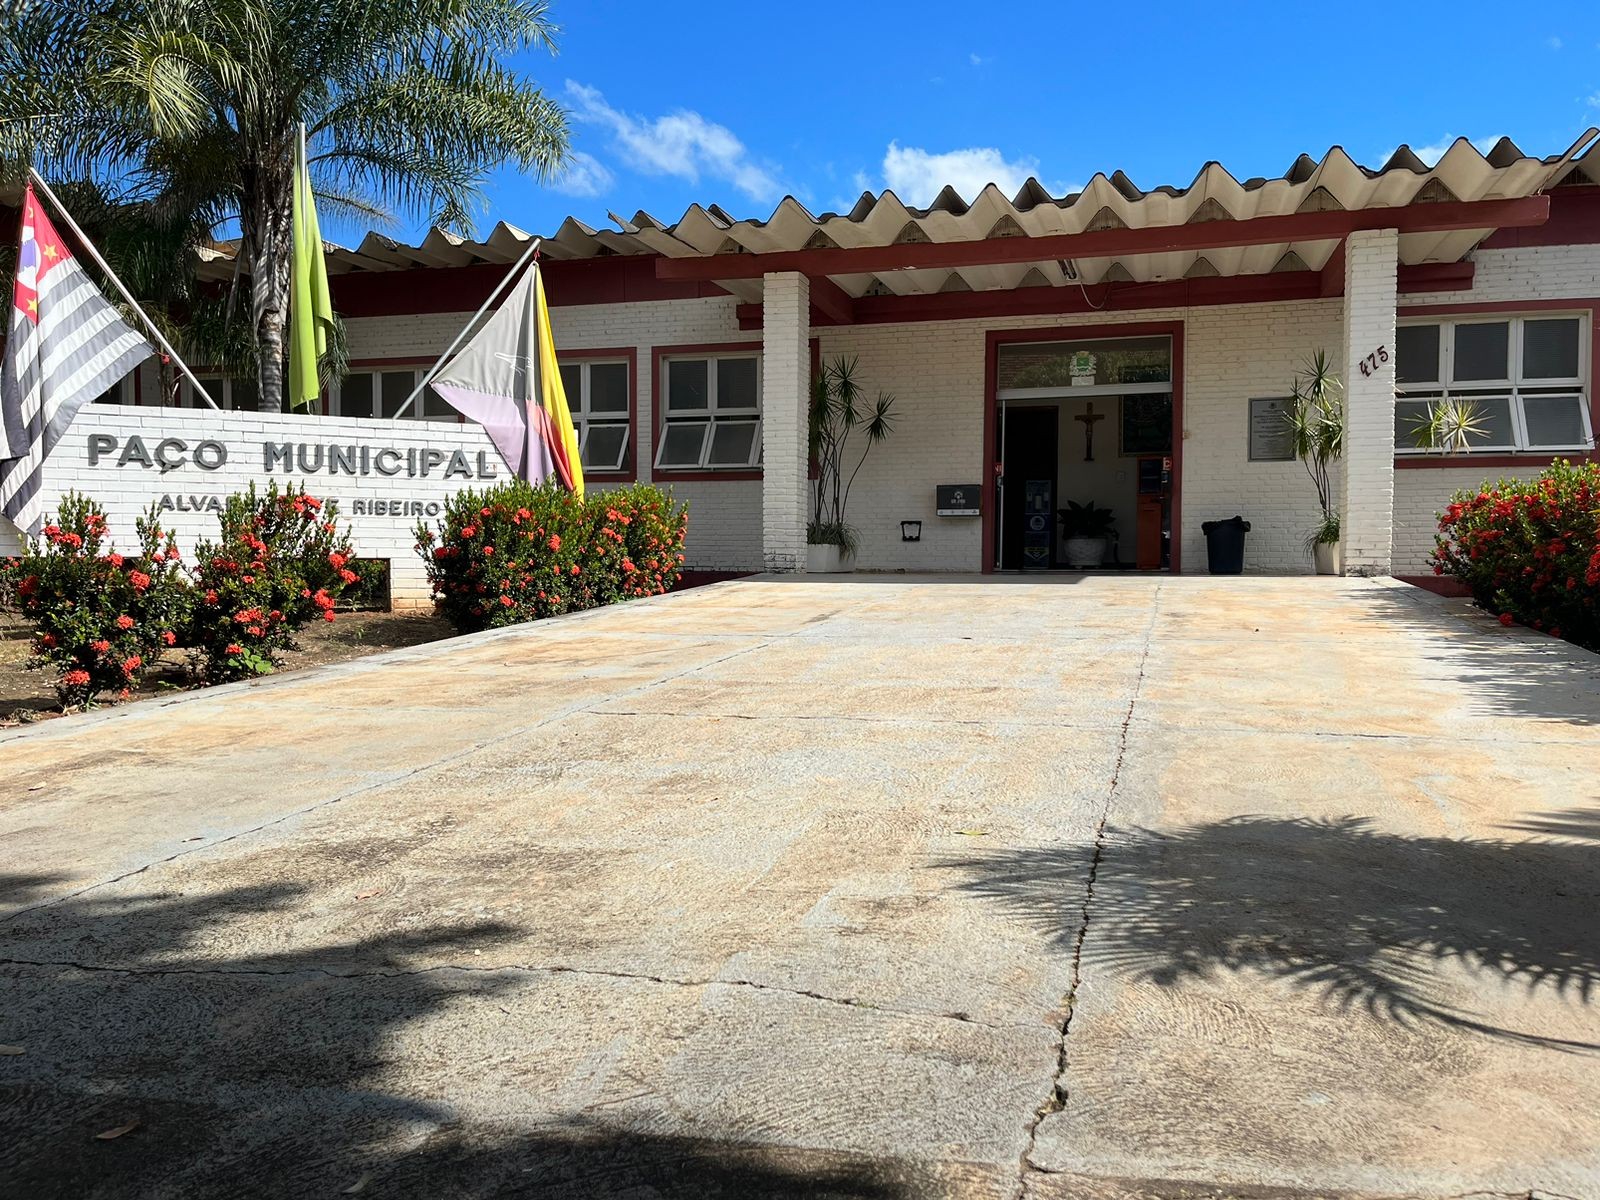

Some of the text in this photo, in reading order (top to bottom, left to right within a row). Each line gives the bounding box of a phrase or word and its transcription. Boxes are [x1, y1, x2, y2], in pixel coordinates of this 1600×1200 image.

[1359, 345, 1389, 377] 475
[87, 433, 498, 480] PAÇO MUNICIPAL
[352, 499, 441, 516] RIBEIRO
